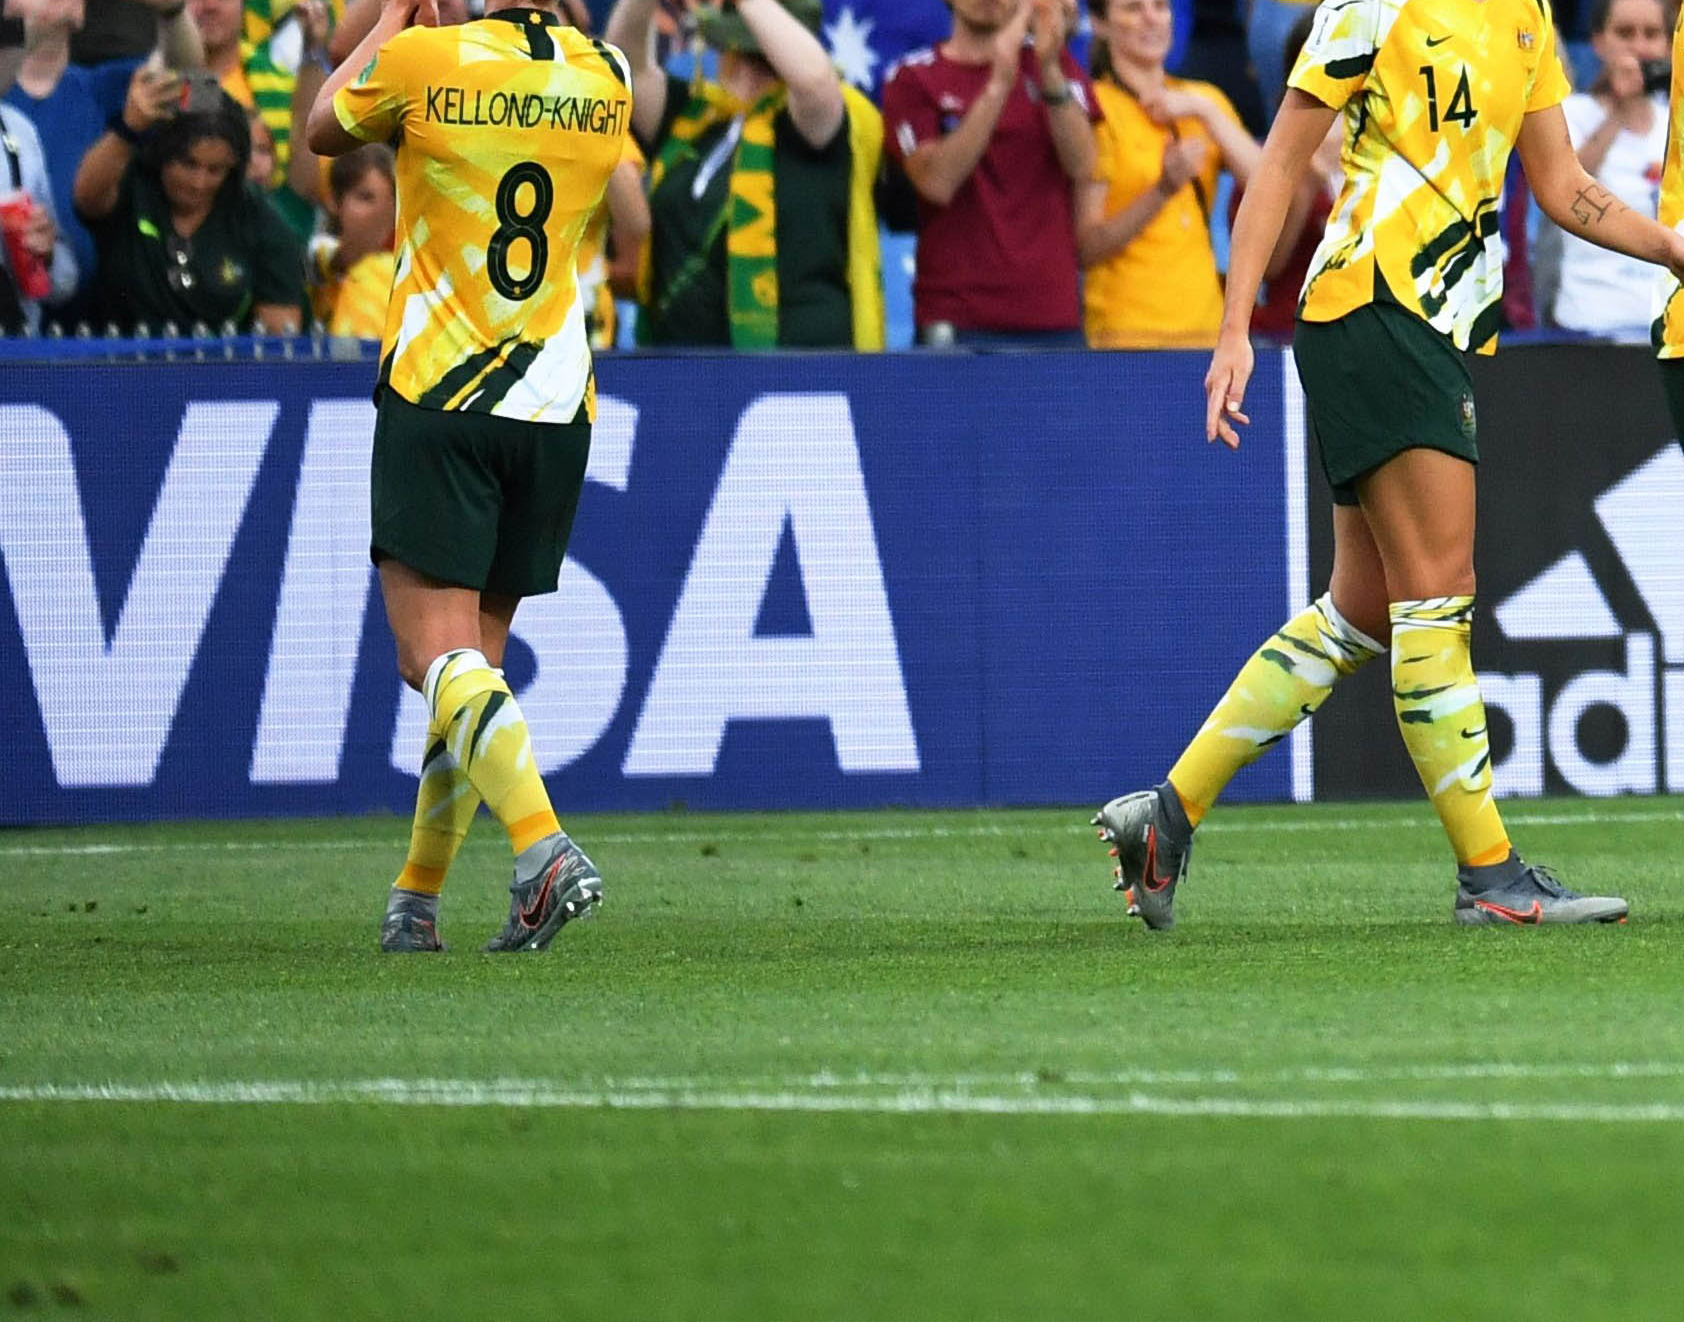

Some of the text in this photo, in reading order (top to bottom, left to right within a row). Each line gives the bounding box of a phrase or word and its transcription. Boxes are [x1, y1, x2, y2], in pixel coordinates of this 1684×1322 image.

[424, 85, 627, 137] KELLOND-KNIGHT
[1418, 62, 1479, 133] 14
[486, 160, 554, 302] 8
